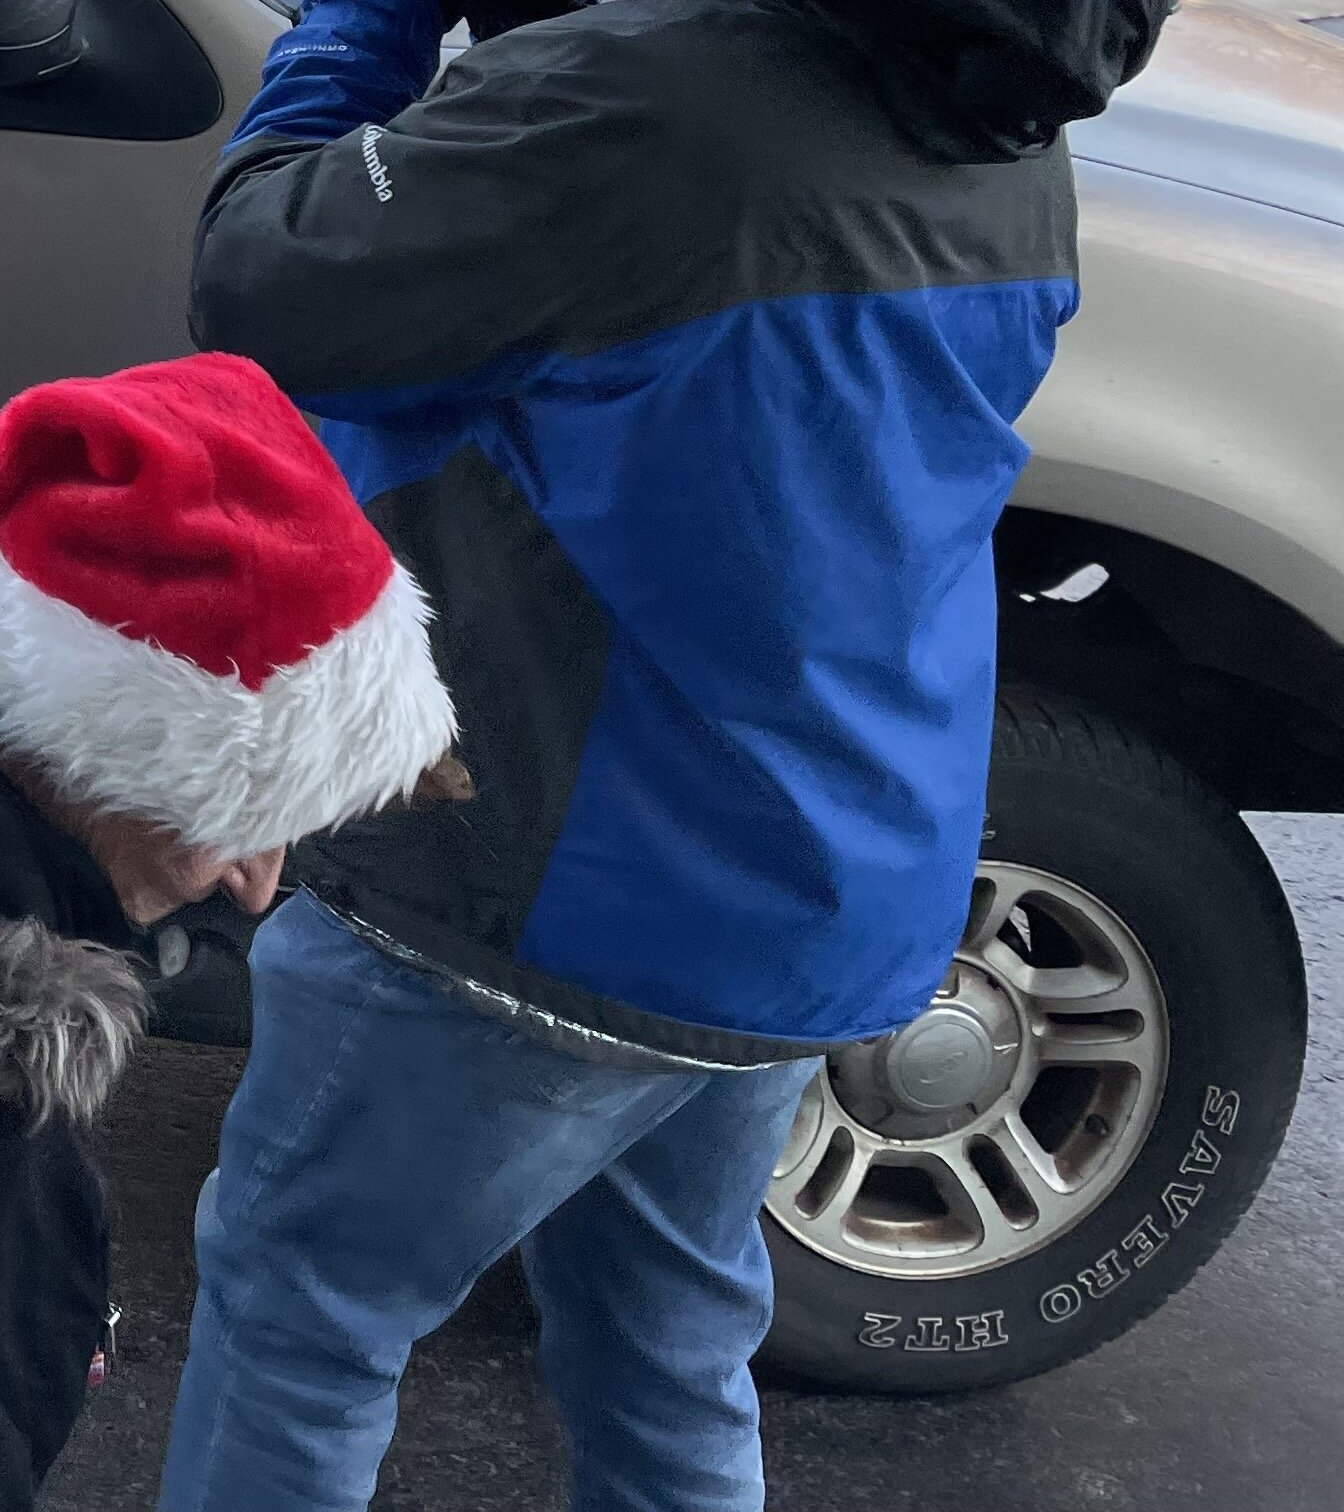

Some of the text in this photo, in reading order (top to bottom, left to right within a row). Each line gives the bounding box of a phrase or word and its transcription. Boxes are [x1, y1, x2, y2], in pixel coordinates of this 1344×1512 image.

[361, 122, 395, 204] Columbia
[858, 1084, 1242, 1353] SAVERO HT2
